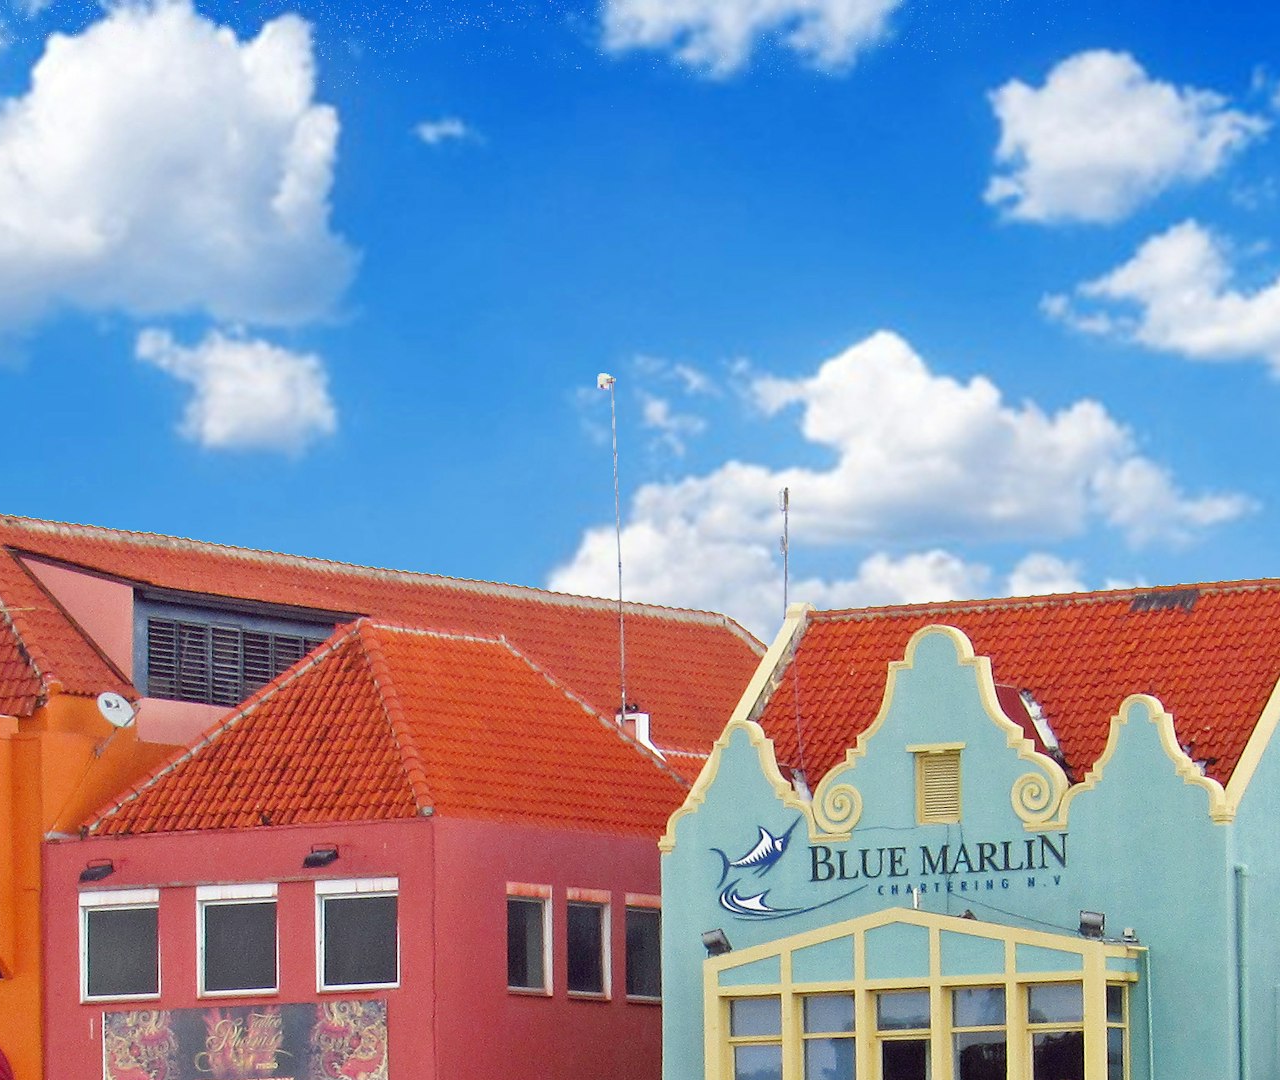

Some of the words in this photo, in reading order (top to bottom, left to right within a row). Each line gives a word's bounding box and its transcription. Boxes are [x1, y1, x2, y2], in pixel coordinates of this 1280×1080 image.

[808, 845, 909, 882] BLUE
[920, 833, 1069, 876] MARLIN
[877, 877, 1010, 896] CHARTERING
